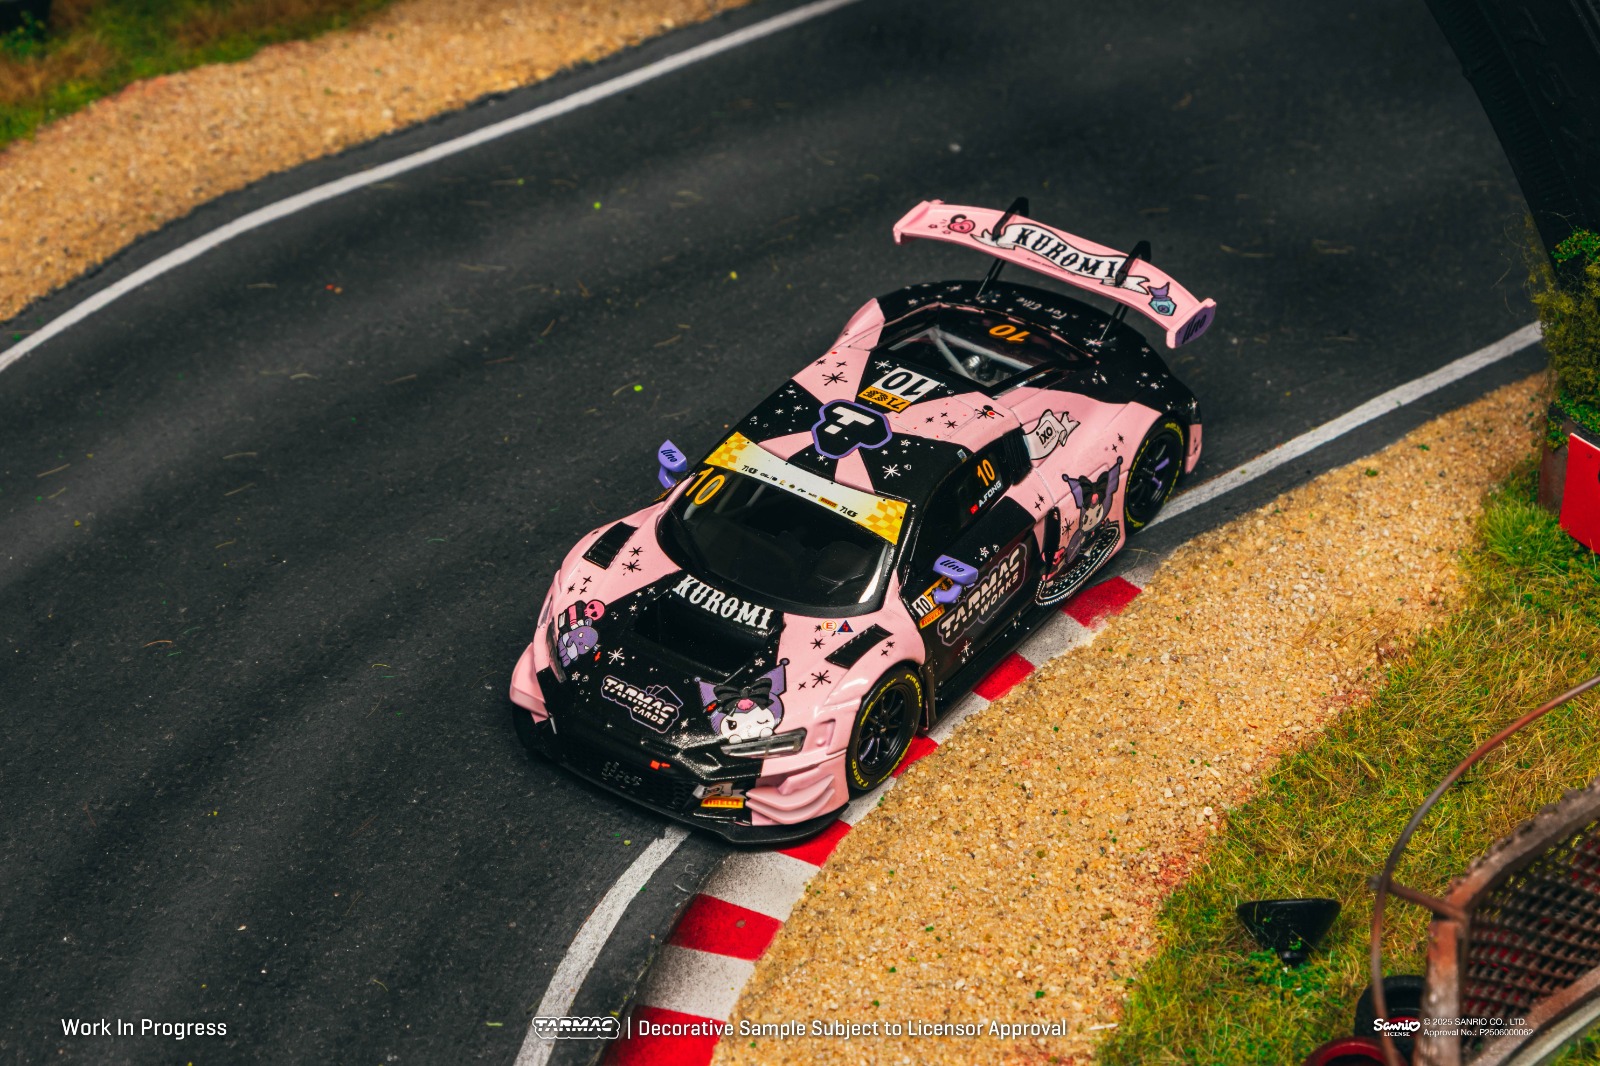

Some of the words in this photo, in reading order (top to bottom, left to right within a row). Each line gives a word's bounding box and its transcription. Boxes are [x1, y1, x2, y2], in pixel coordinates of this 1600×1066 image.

[1012, 227, 1118, 278] KUROMI
[989, 324, 1031, 343] 10
[881, 371, 930, 397] 10
[685, 466, 726, 505] 10
[977, 459, 996, 487] 10
[672, 574, 775, 630] KUROMI
[915, 597, 932, 616] 10
[941, 548, 1020, 638] TARMAC
[980, 571, 1019, 616] WORKS
[603, 678, 675, 719] TARMAC
[904, 673, 922, 708] PIRELLI
[632, 706, 666, 725] CARDS
